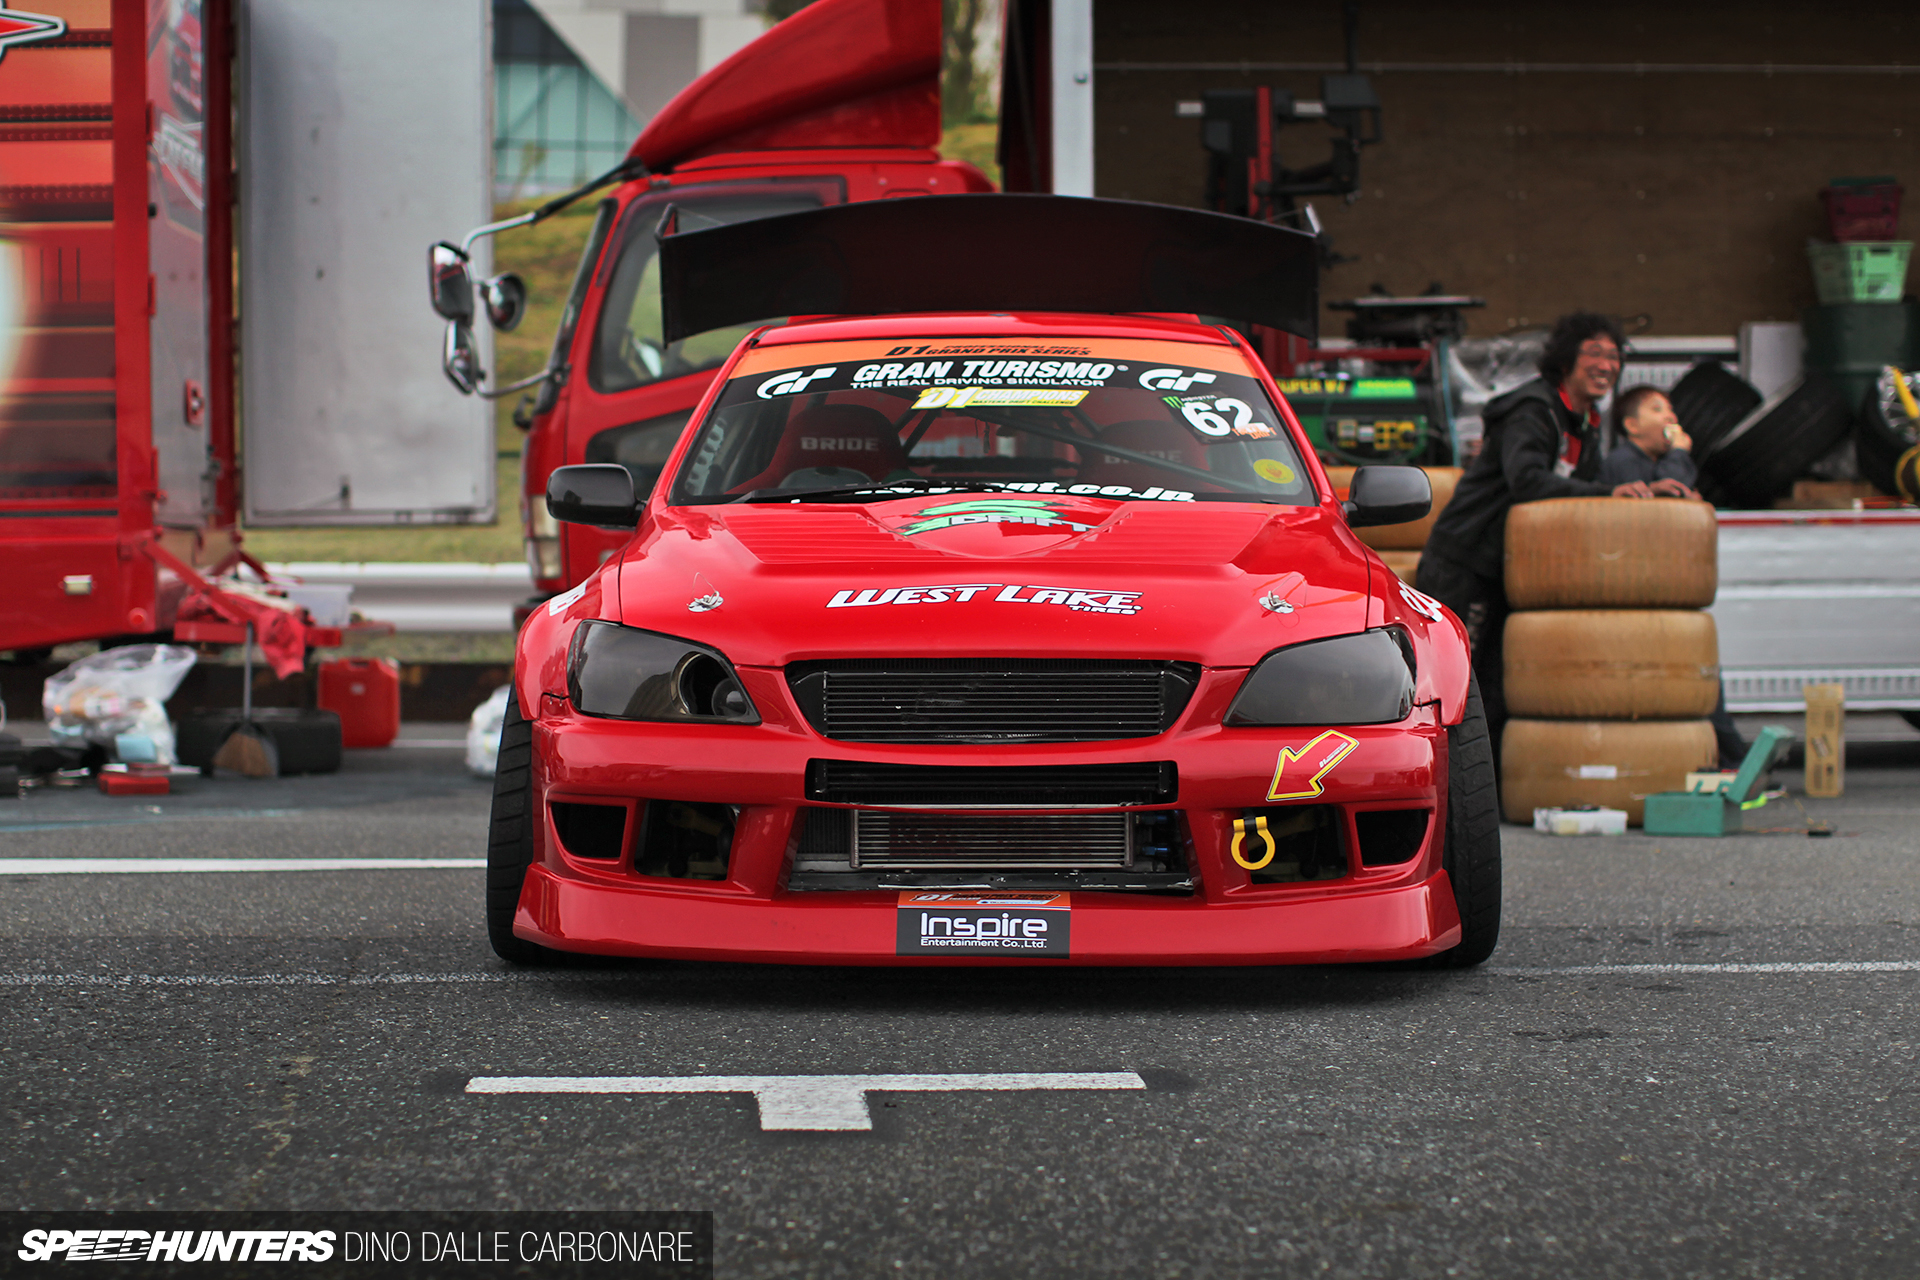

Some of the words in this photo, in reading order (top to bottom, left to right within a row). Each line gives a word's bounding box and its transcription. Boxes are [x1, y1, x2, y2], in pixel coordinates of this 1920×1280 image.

[853, 361, 955, 382] GRAN
[850, 381, 883, 389] THE
[886, 379, 930, 387] REAL
[934, 378, 1003, 386] DRIVING
[1006, 378, 1105, 387] SIMULATOR
[974, 390, 1084, 401] CHAMPIONS
[1181, 398, 1271, 436] 62
[801, 437, 879, 451] BRIDE
[825, 584, 1003, 608] WEST
[1069, 605, 1137, 615] TIRES
[921, 912, 1048, 940] Inspire
[921, 939, 999, 947] Entertainment
